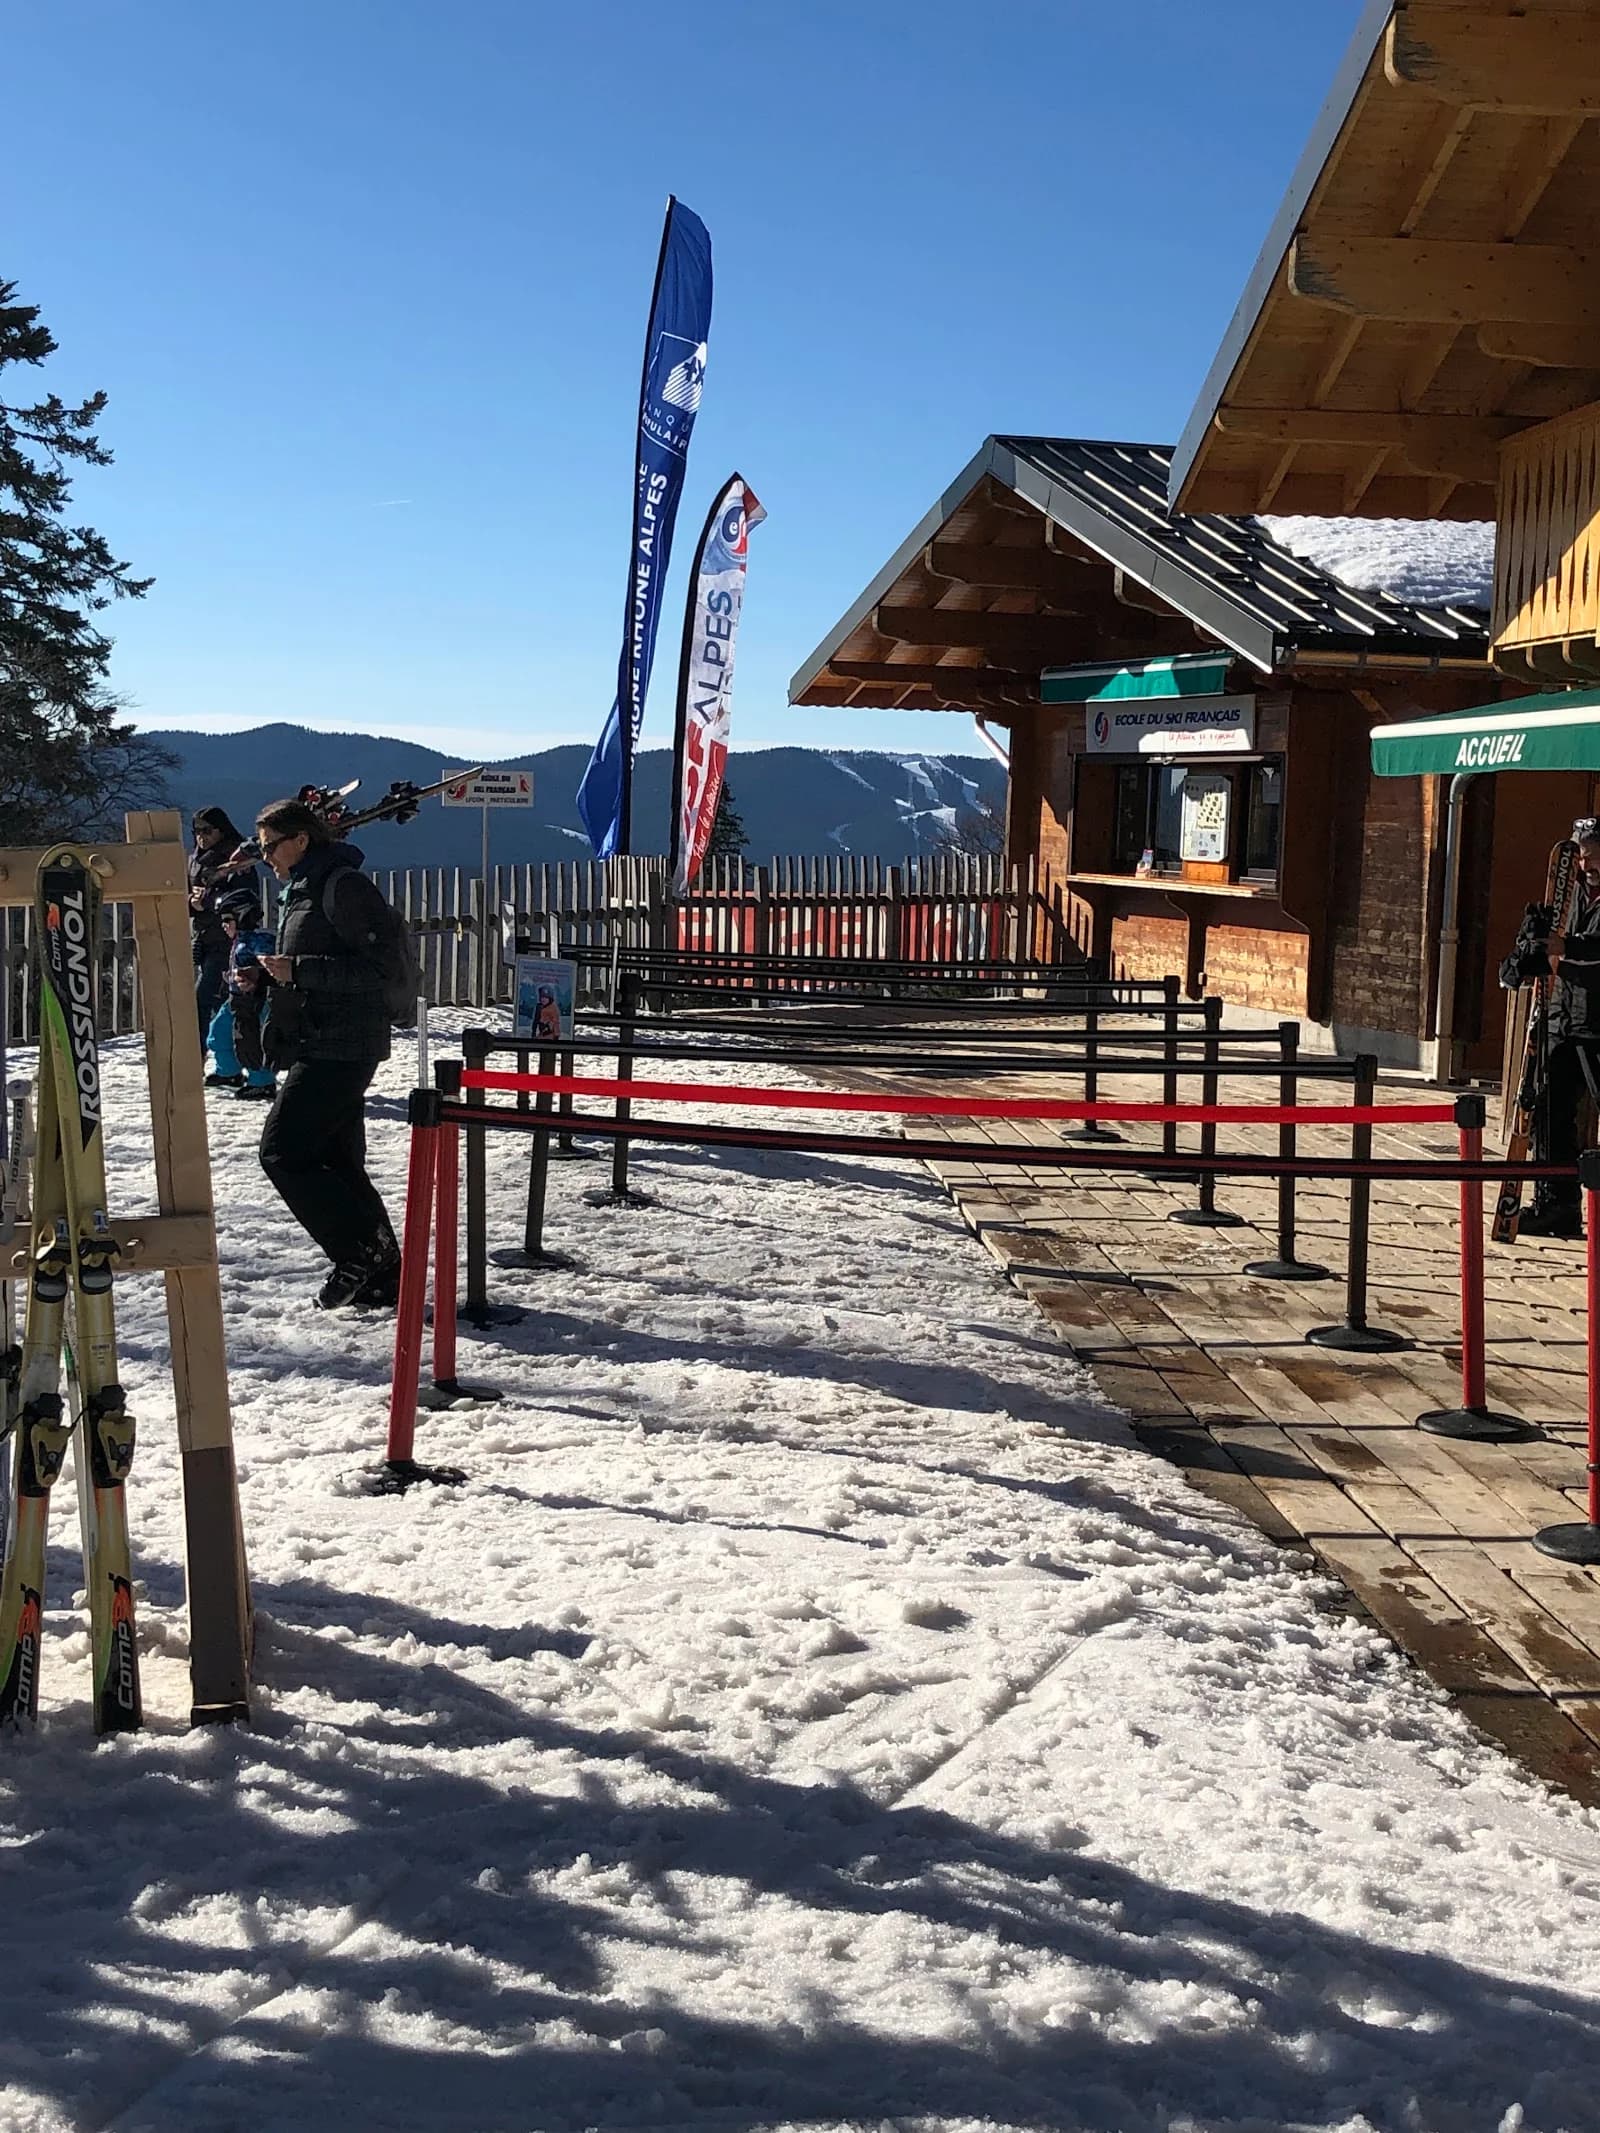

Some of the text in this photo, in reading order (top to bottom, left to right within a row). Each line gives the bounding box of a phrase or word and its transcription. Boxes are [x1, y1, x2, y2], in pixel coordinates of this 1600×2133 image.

[638, 471, 668, 558] ALPES
[1115, 709, 1241, 727] ECOLE DU SKI FRANÇAIS
[1454, 733, 1527, 767] ACCUEIL
[64, 890, 101, 1121] ROSSIGNOL
[118, 1621, 134, 1710] Comp
